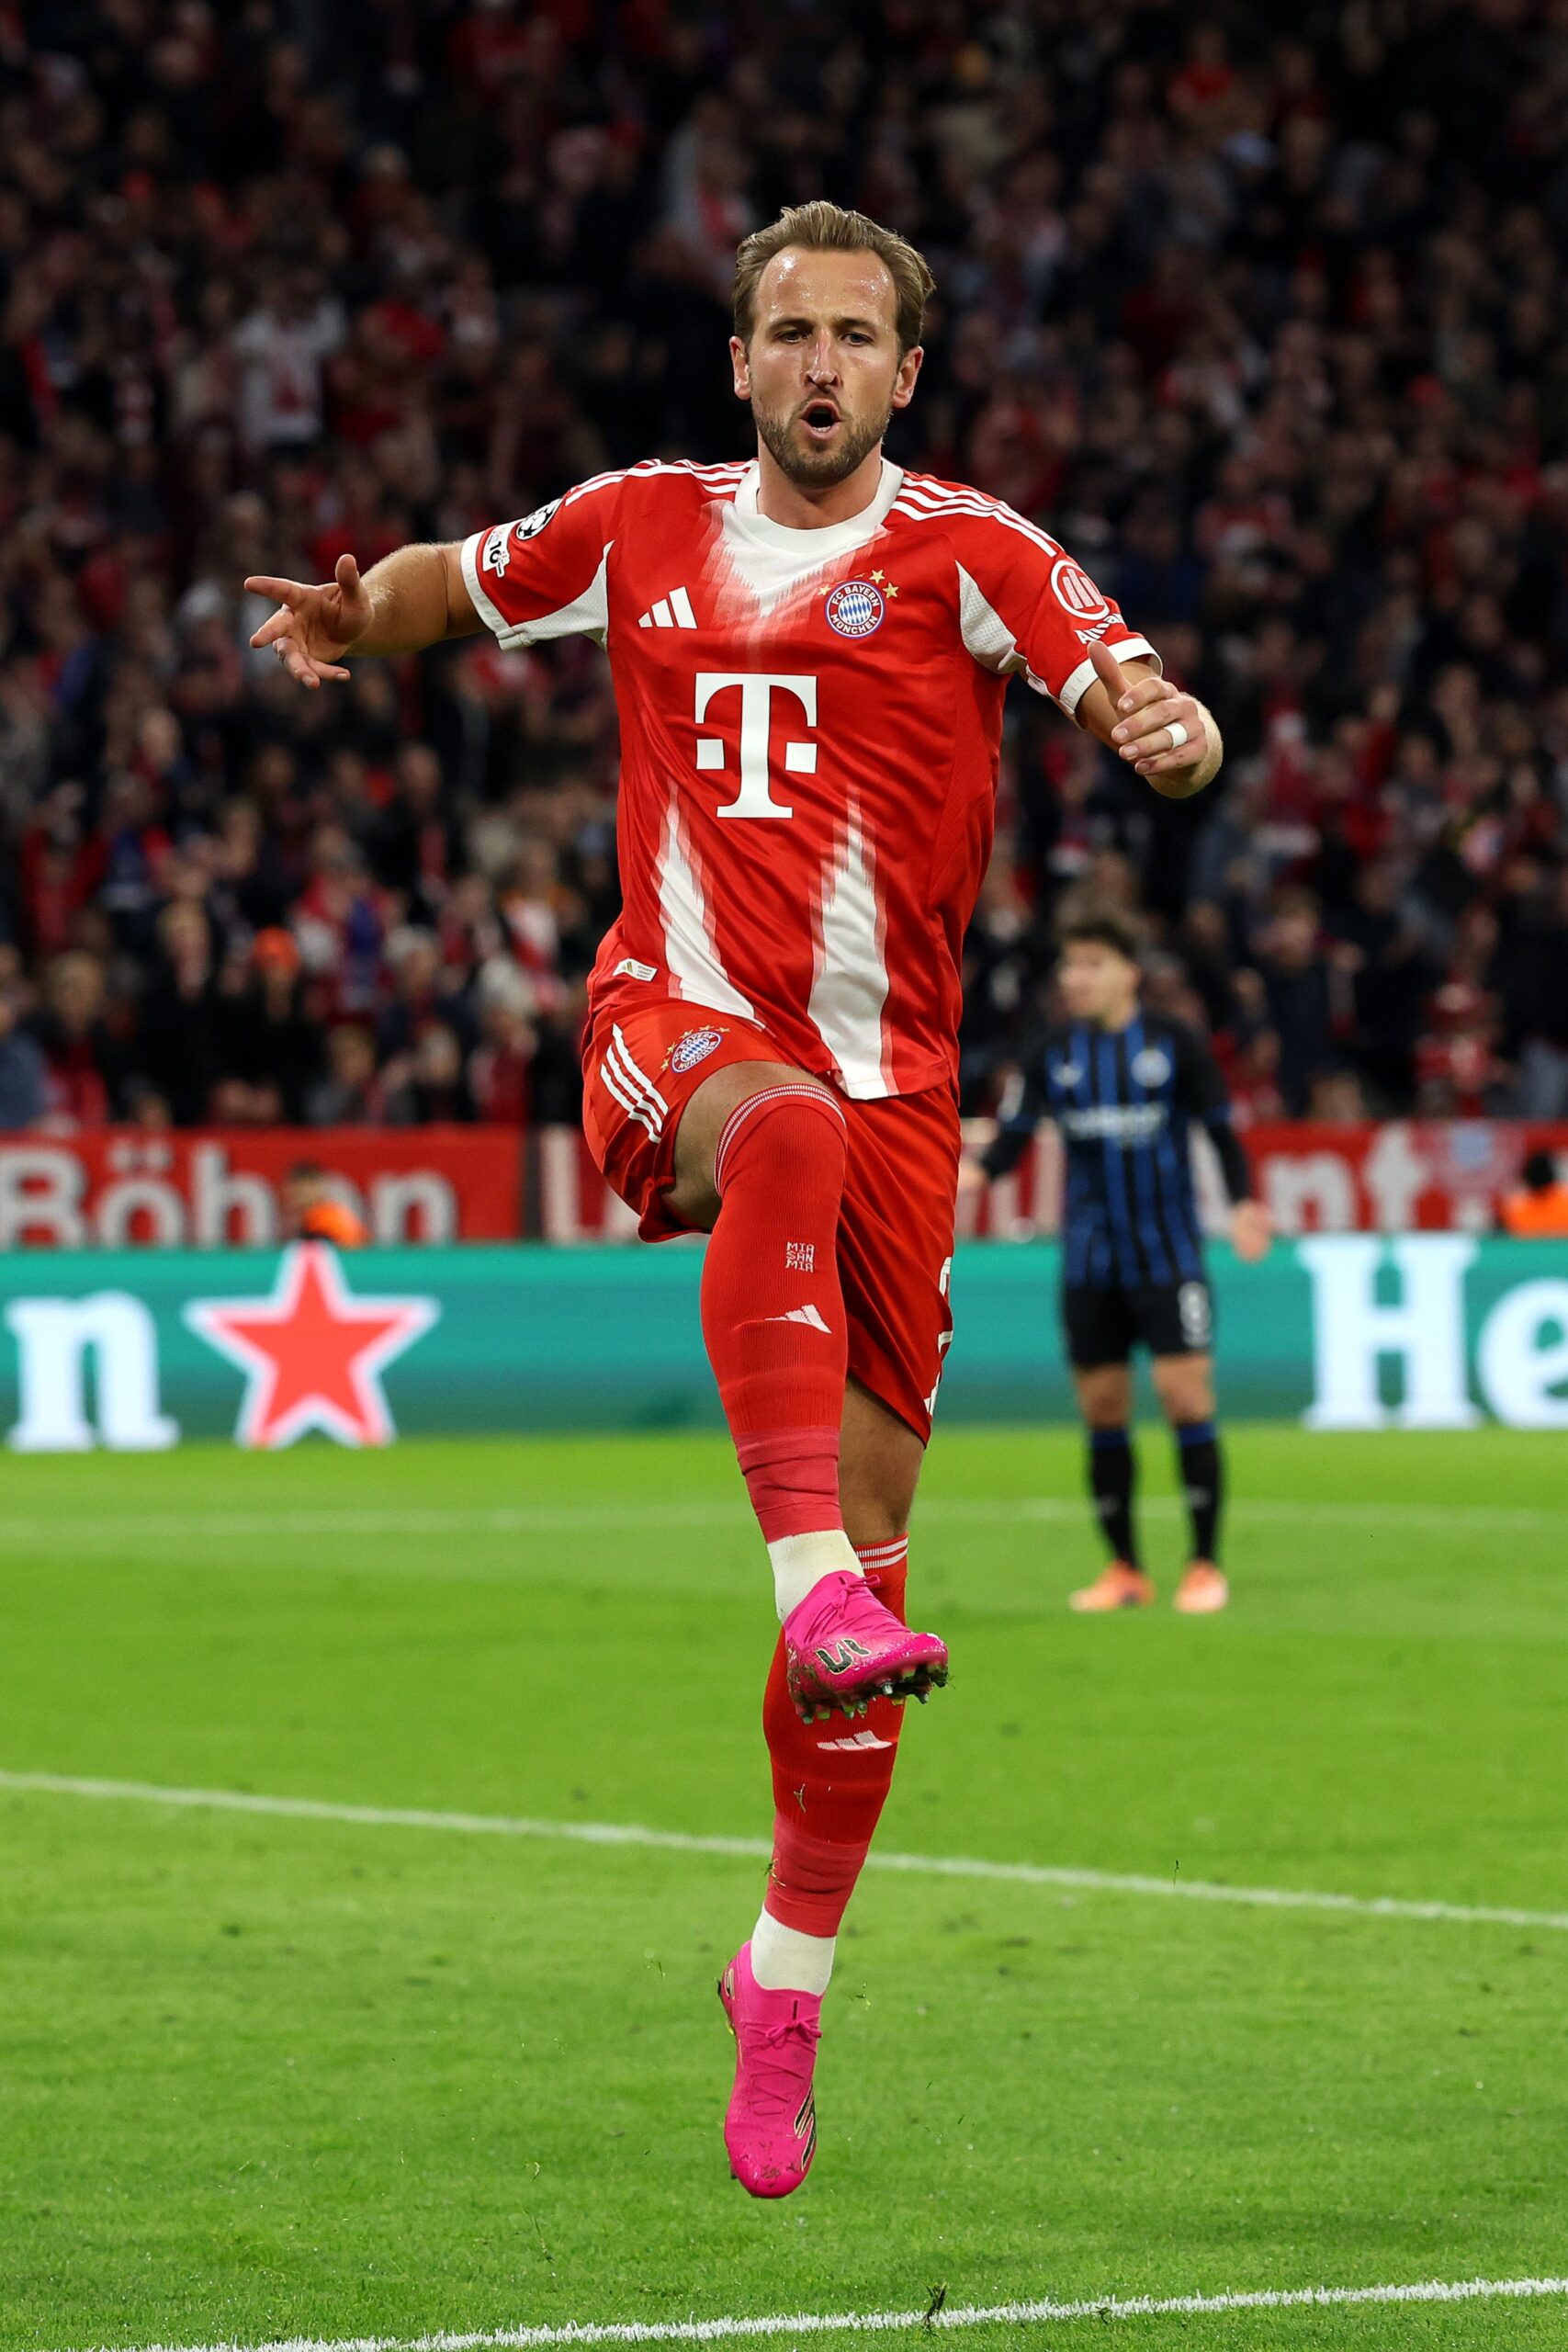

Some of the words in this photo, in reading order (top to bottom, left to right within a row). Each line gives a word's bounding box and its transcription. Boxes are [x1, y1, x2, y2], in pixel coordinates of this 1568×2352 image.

[832, 592, 844, 605] FC
[844, 584, 879, 606] BAYERN
[830, 613, 878, 634] MÜNCHEN
[786, 1241, 815, 1254] MIA
[786, 1250, 814, 1263] SAN
[785, 1259, 814, 1272] MIA
